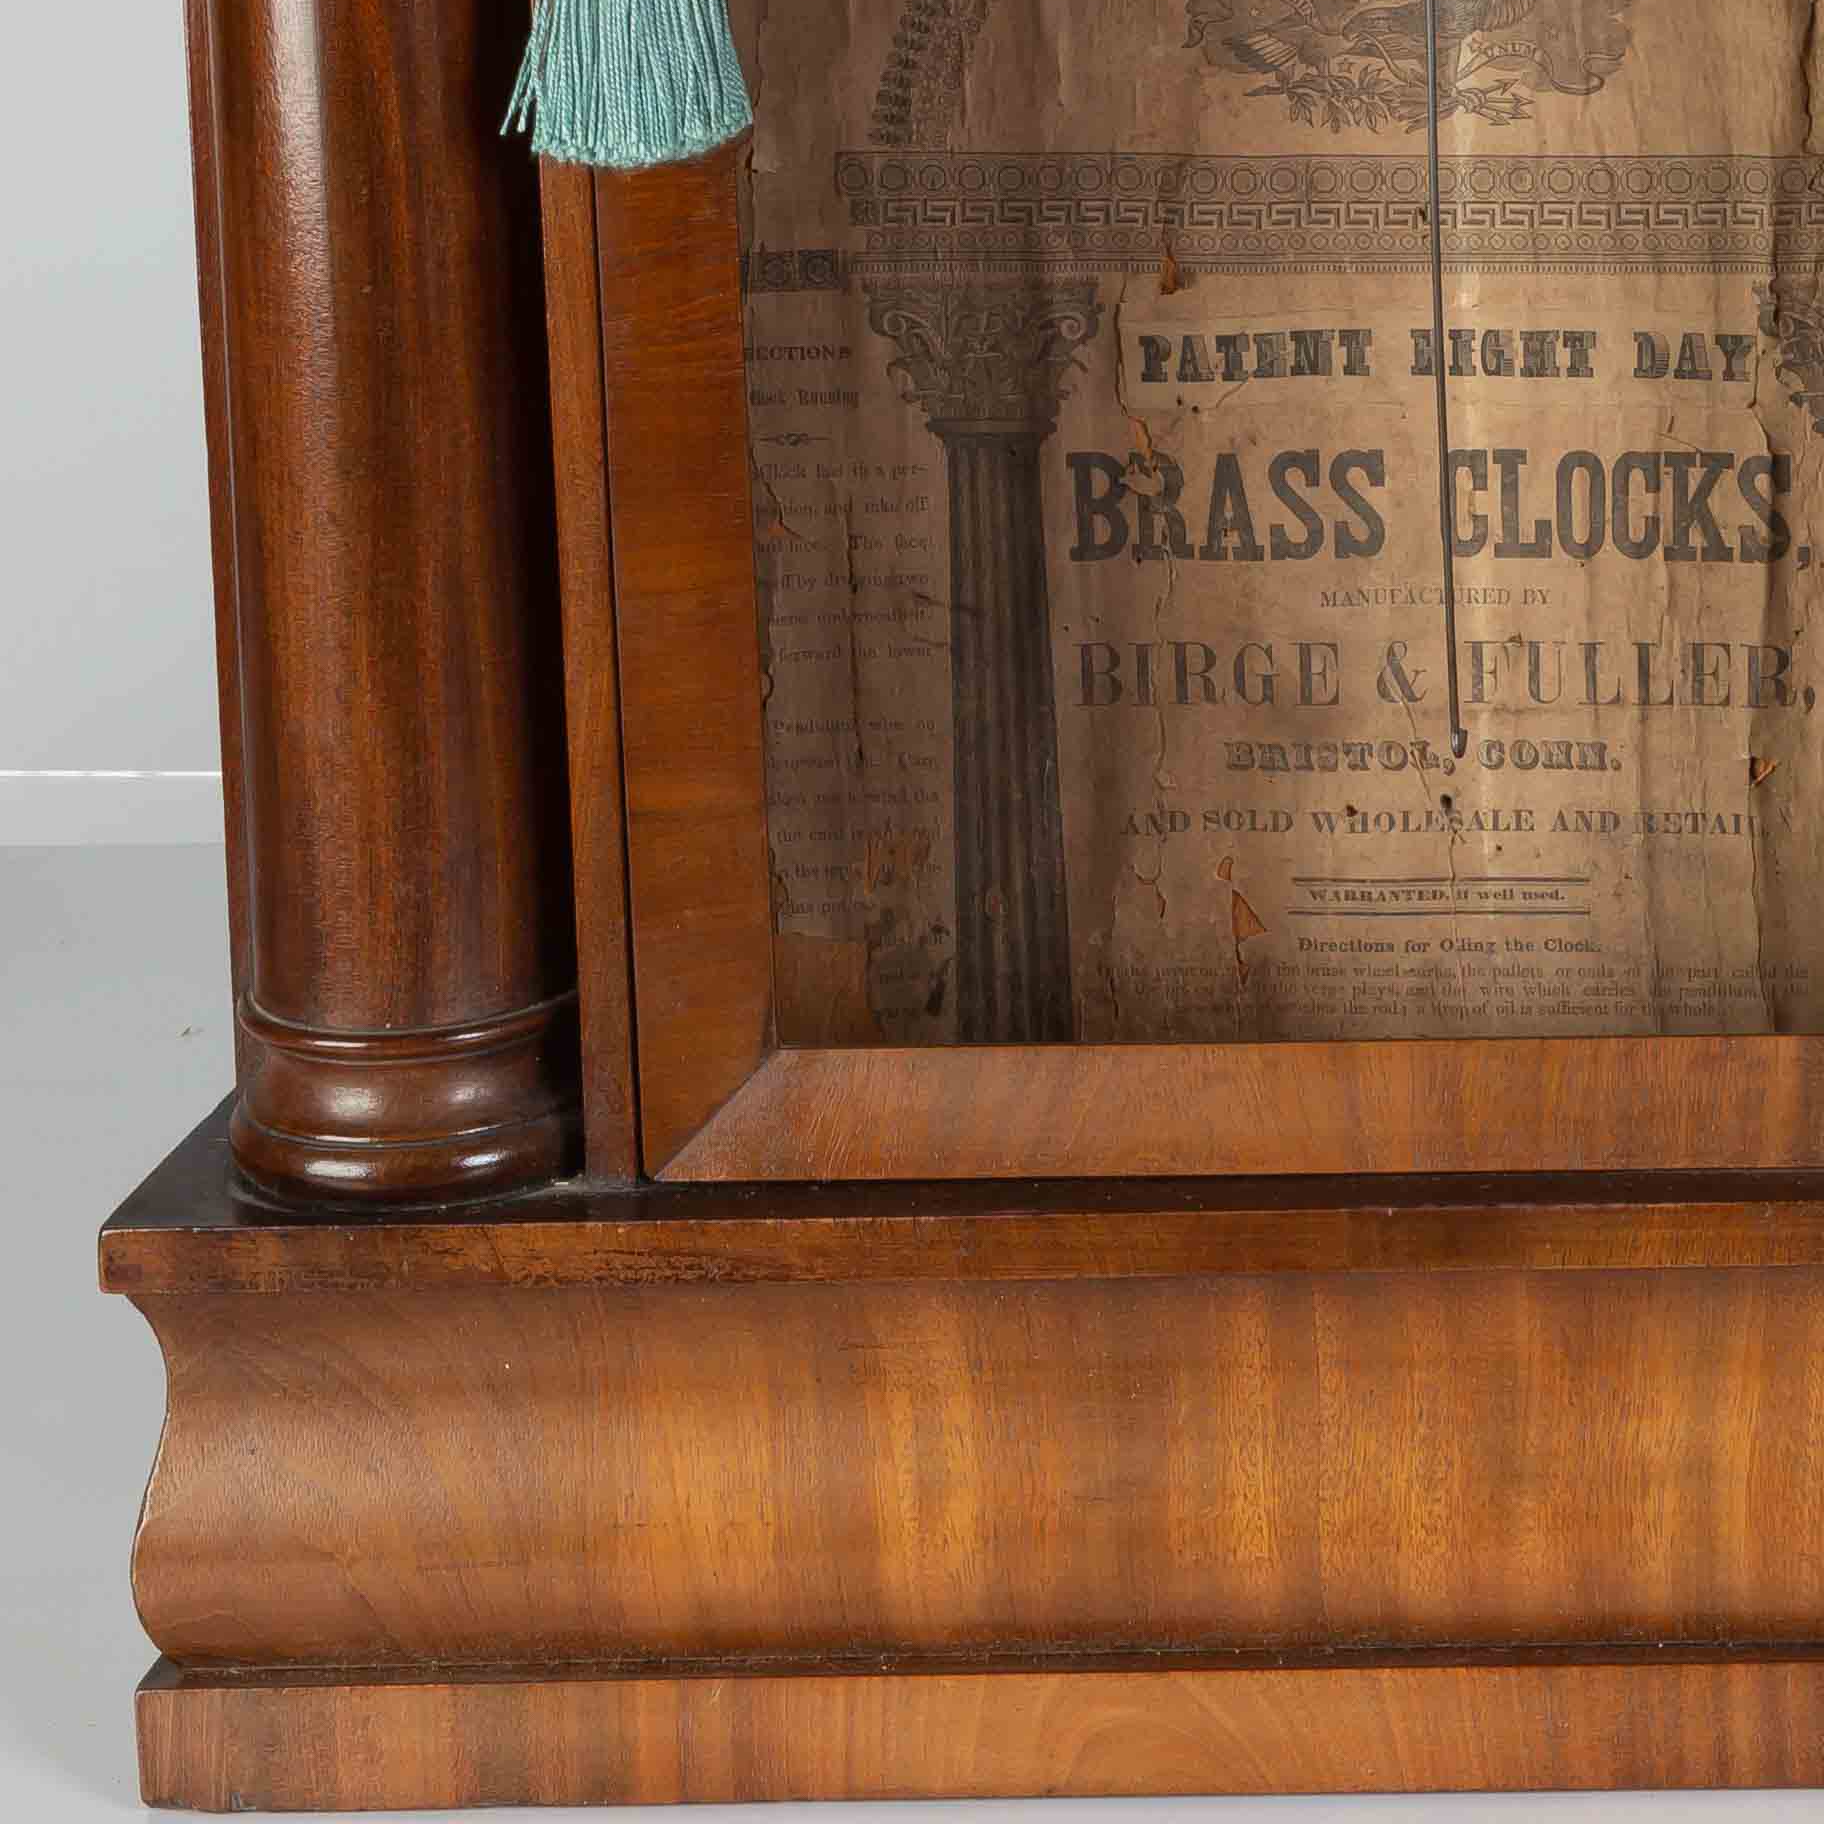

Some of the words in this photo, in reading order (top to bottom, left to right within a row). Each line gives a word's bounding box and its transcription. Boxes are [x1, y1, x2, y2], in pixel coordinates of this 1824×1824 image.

[1139, 329, 1372, 383] PATENT
[1410, 327, 1597, 379] EIGHT
[1633, 331, 1756, 382] DAY
[1066, 447, 1387, 564] BRASS
[1448, 448, 1811, 567] CLOCKS,
[1319, 586, 1511, 608] MANUFACTURED
[1522, 587, 1551, 605] BY
[1074, 640, 1342, 707] BIRGE
[1375, 638, 1430, 706] &
[1462, 639, 1817, 715] FULLER,
[1120, 810, 1191, 836] AND
[1201, 809, 1294, 833] SOLD
[1550, 809, 1621, 835] AND
[1298, 937, 1395, 953] Directions
[1403, 939, 1431, 953] for
[1504, 938, 1534, 952] the
